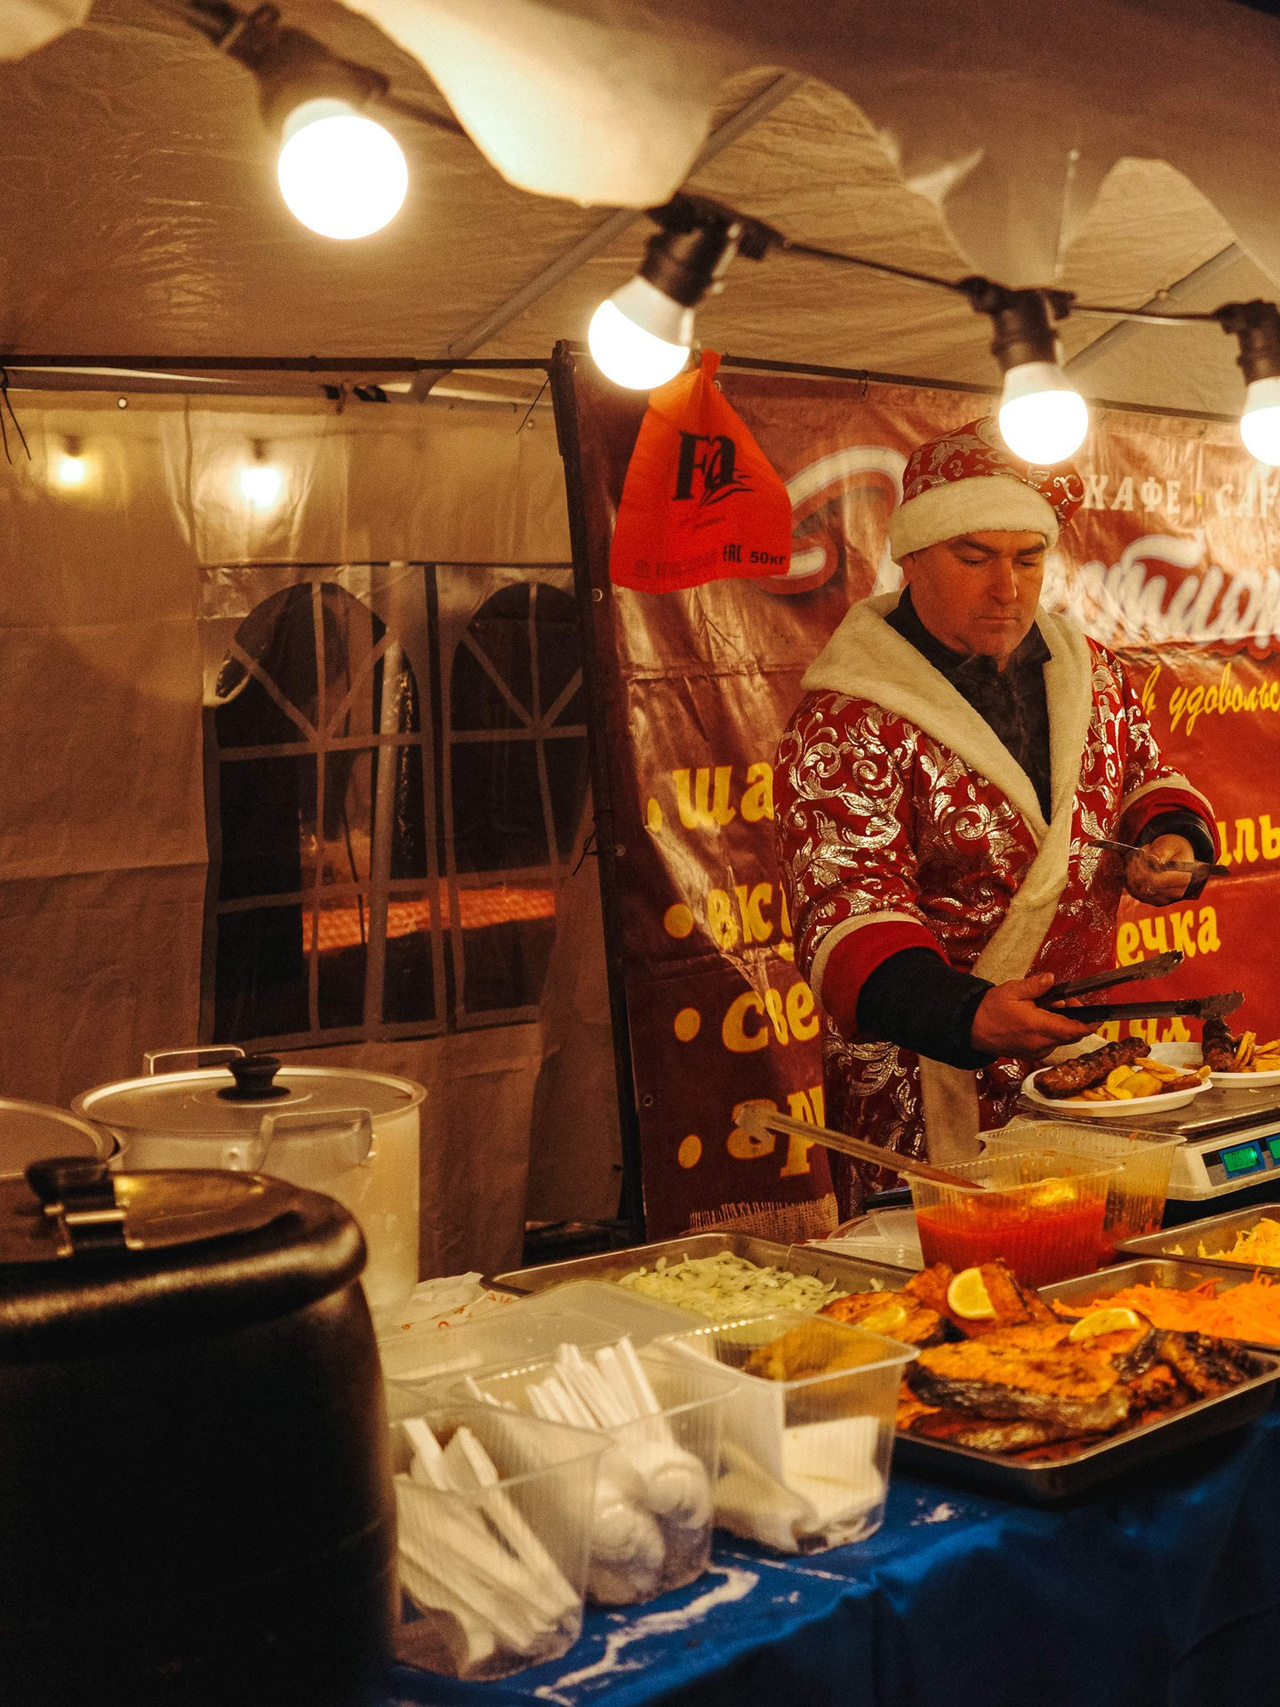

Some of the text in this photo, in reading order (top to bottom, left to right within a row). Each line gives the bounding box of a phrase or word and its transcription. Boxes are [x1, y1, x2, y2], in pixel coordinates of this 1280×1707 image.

[1082, 474, 1182, 515] КАФЕ
[750, 551, 787, 566] 50кг
[672, 761, 775, 830] ша
[721, 906, 1221, 1053] све ечка
